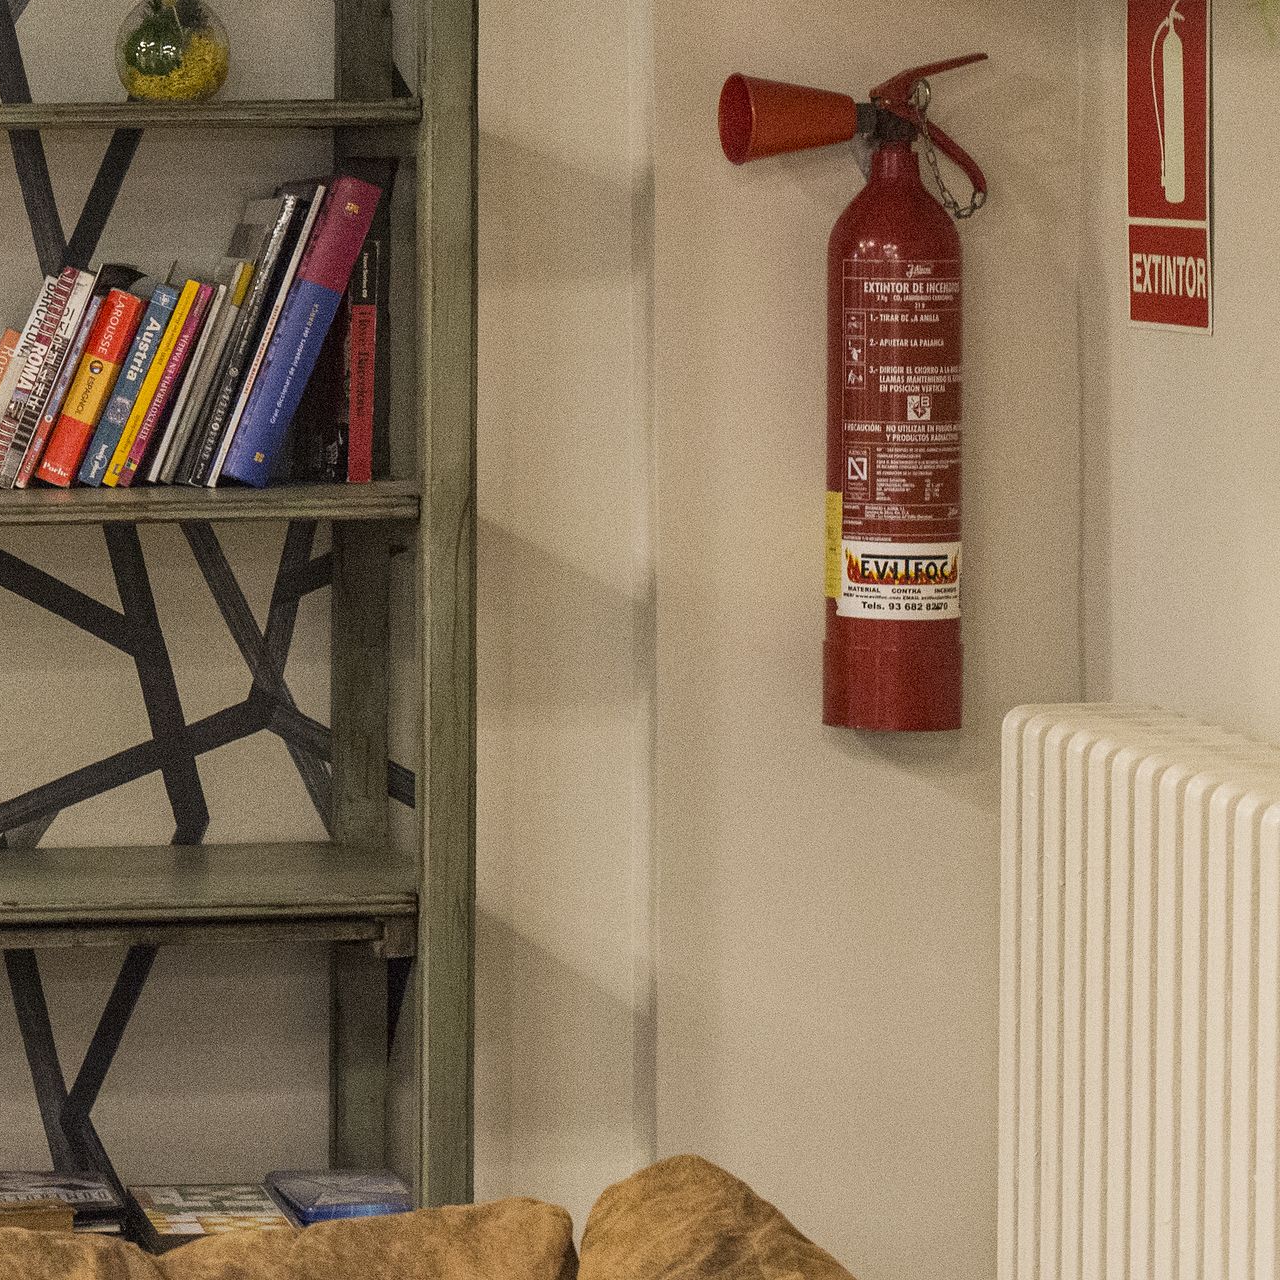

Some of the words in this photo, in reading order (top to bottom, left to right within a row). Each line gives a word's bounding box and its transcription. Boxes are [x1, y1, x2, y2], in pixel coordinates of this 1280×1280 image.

[1132, 252, 1207, 299] EXTINTOR
[863, 282, 909, 293] EXTINTOR
[913, 282, 924, 293] DE
[880, 314, 900, 322] TIRAR
[919, 314, 939, 322] ANILLA
[99, 294, 127, 356] LAROUSSE
[302, 325, 312, 338] del
[171, 331, 190, 362] PAREJA
[910, 339, 918, 347] LA
[919, 339, 944, 347] PALANCA
[125, 317, 162, 383] Austria
[290, 337, 308, 367] jugadors
[18, 341, 46, 393] ROMA
[166, 360, 178, 374] EN
[287, 366, 296, 376] de
[880, 366, 904, 374] DIRIGIR
[906, 366, 913, 374] EL
[914, 366, 938, 374] CHORRO
[880, 375, 905, 383] LLAMAS
[906, 375, 946, 383] MANTENIENDO
[274, 374, 293, 408] diccionari
[880, 384, 888, 392] EN
[889, 384, 919, 392] POSICIÓN
[921, 384, 946, 392] VERTICAL
[73, 375, 96, 417] ESPAGNOL
[138, 371, 173, 441] REFLEXOTERAPIA
[268, 407, 280, 424] Gran
[886, 424, 896, 432] NO
[897, 424, 926, 432] UTILIZAR
[927, 424, 935, 432] EN
[886, 433, 890, 441] Y
[892, 433, 929, 441] PRODUCTOS
[847, 585, 880, 593] MATERIAL
[861, 601, 885, 610] Tels.
[888, 603, 901, 611] 93
[904, 602, 923, 611] 682
